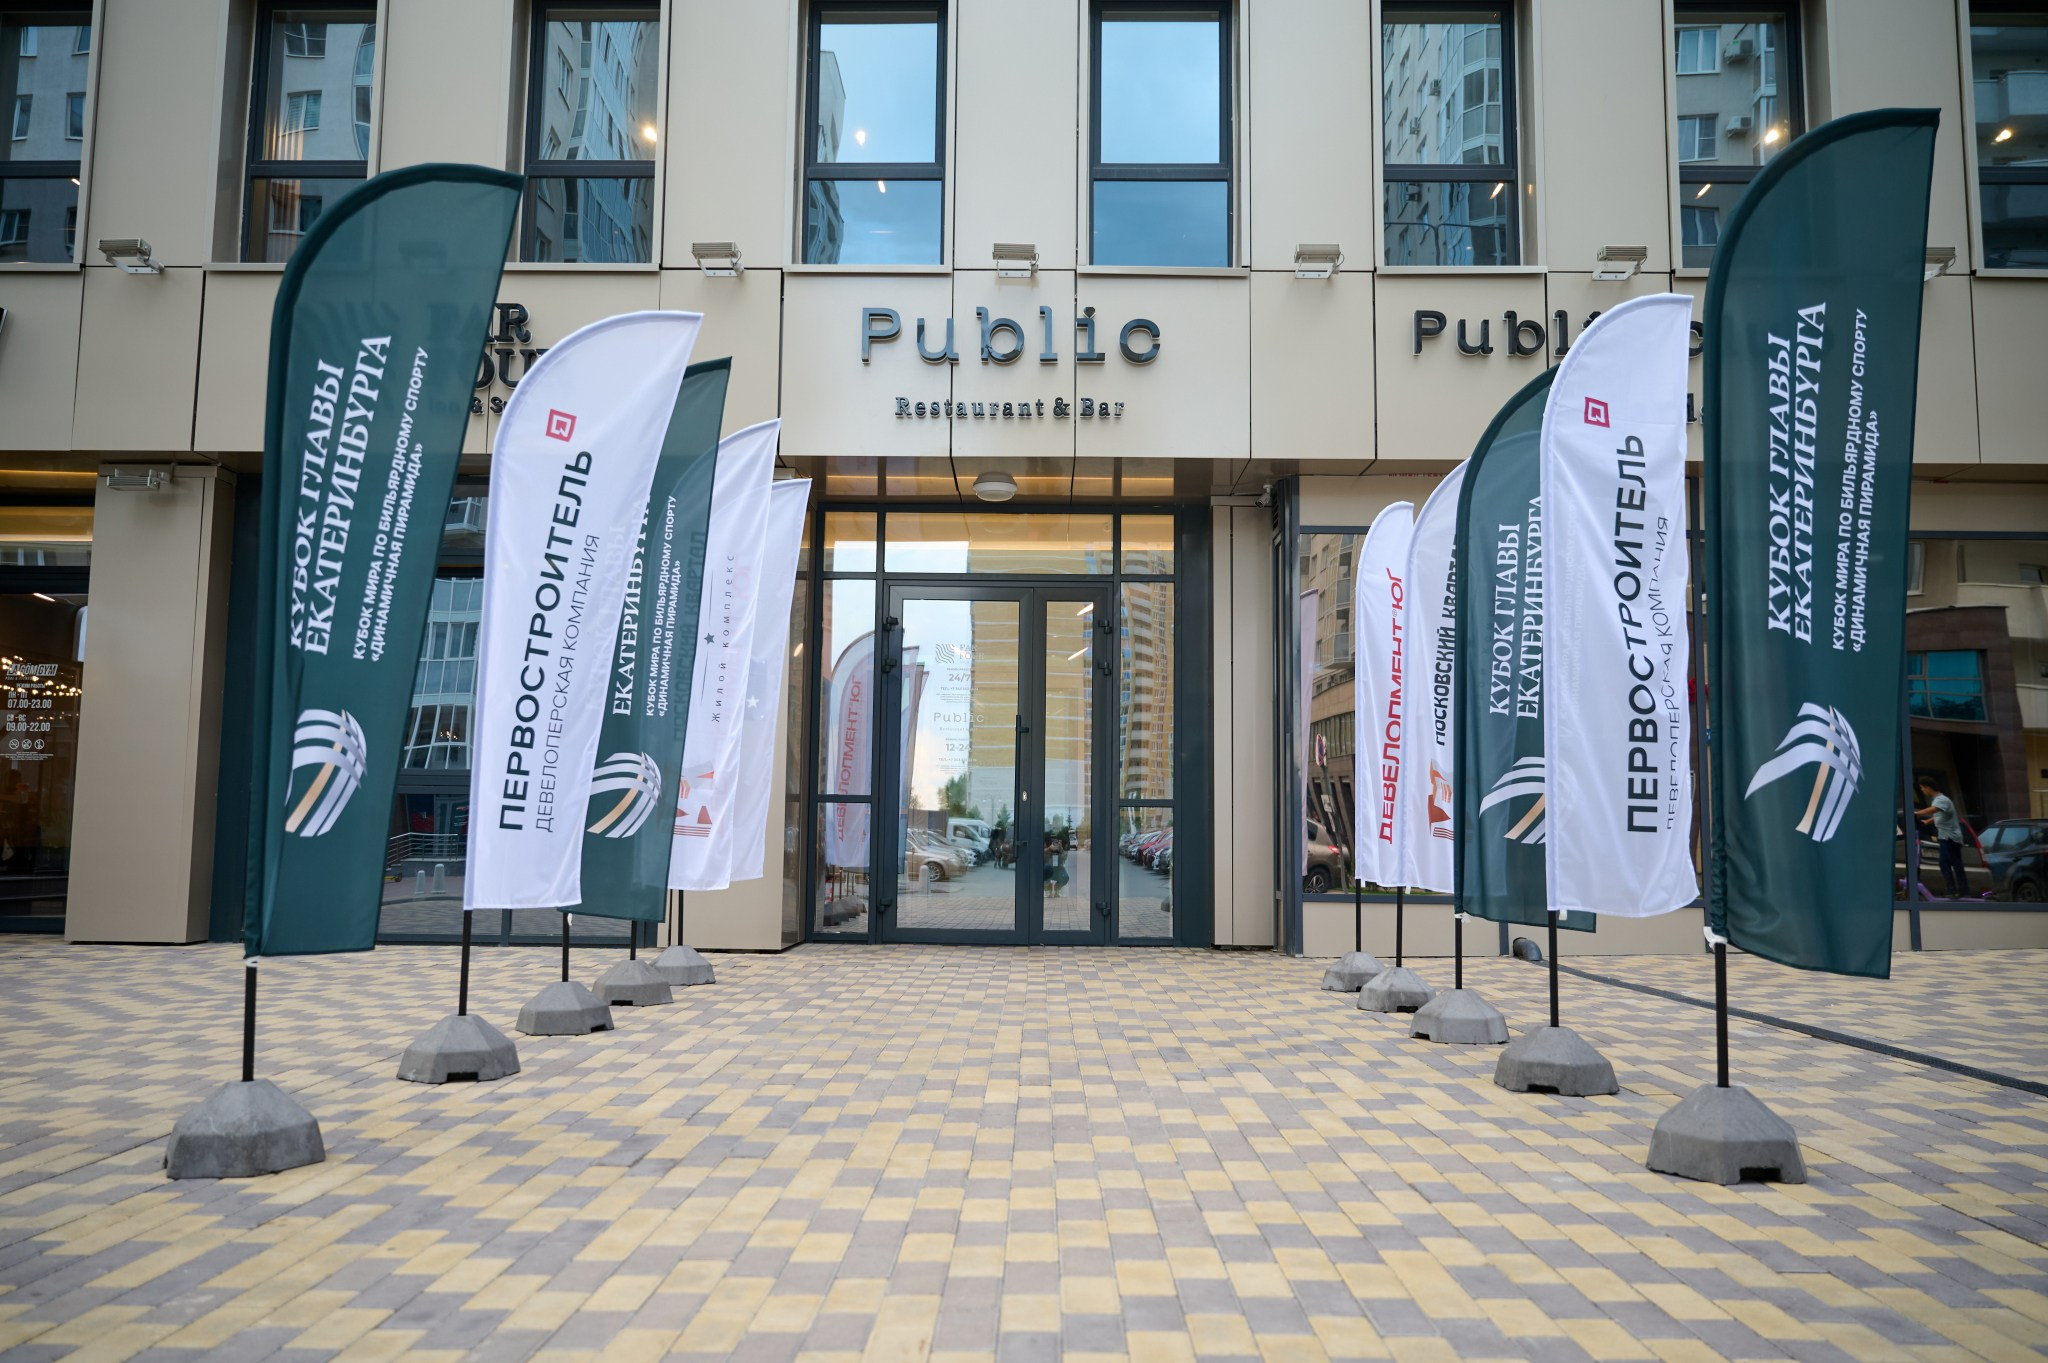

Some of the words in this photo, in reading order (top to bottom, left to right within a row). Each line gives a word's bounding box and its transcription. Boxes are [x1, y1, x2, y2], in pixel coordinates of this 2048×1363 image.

[861, 306, 1161, 364] Public
[1413, 310, 1602, 357] Publ
[1852, 308, 1867, 377] СПОРТУ
[404, 346, 429, 411] СПОРТУ
[895, 397, 1044, 419] Restaurant
[1053, 397, 1070, 419] &
[1080, 397, 1125, 419] Bar
[1768, 332, 1791, 480] ГЛАВЫ
[300, 358, 344, 502] ГЛАВЫ
[378, 411, 414, 531] БИЛЬЯРДНОМУ
[1794, 302, 1826, 645] ЕКАТЕРИНБУРГА
[1841, 379, 1864, 510] БИЛЬЯРДНОМУ
[1859, 410, 1879, 513] ПИРАМИДА»
[304, 335, 392, 655] ЕКАТЕРИНБУРГА
[664, 496, 677, 540] СПОРТУ
[1839, 512, 1853, 537] ПО
[290, 506, 317, 649] КУБОК
[363, 560, 384, 604] МИРА
[371, 542, 403, 662] «ДИНАМИЧНАЯ
[393, 443, 424, 539] ПИРАМИДА»
[373, 533, 388, 557] ПО
[655, 542, 672, 625] БИЛЬЯРДНОМУ
[1494, 523, 1520, 617] ГЛАВЫ
[1768, 483, 1791, 635] КУБОК
[1836, 541, 1850, 590] МИРА
[1850, 520, 1871, 653] «ДИНАМИЧНАЯ
[353, 606, 373, 660] КУБОК
[612, 495, 650, 716] ЕКАТЕРИНБ
[653, 627, 662, 644] ПО
[665, 560, 681, 629] ПИРАМИДА»
[712, 662, 727, 722] Жилой
[722, 555, 735, 648] комплекс
[1614, 435, 1658, 833] ПЕРВОСТРОИТЕЛЬ
[1833, 592, 1847, 651] КУБОК
[499, 450, 593, 831] ПЕРВОСТРОИТЕЛЬ
[535, 656, 575, 833] ДЕВЕЛОПЕРСКАЯ
[563, 535, 600, 651] КОМПАНИЯ
[650, 647, 661, 676] МИРА
[1489, 621, 1514, 716] КУБОК
[6, 722, 51, 731] 09.00-22.00
[8, 699, 52, 708] 07.00-23.00
[646, 677, 657, 717] КУБОК
[933, 712, 985, 723] Public
[1379, 618, 1402, 844] ДЕВЕЛОПМЕНТ
[836, 709, 858, 842] ДЕВЛОПМЕНТ
